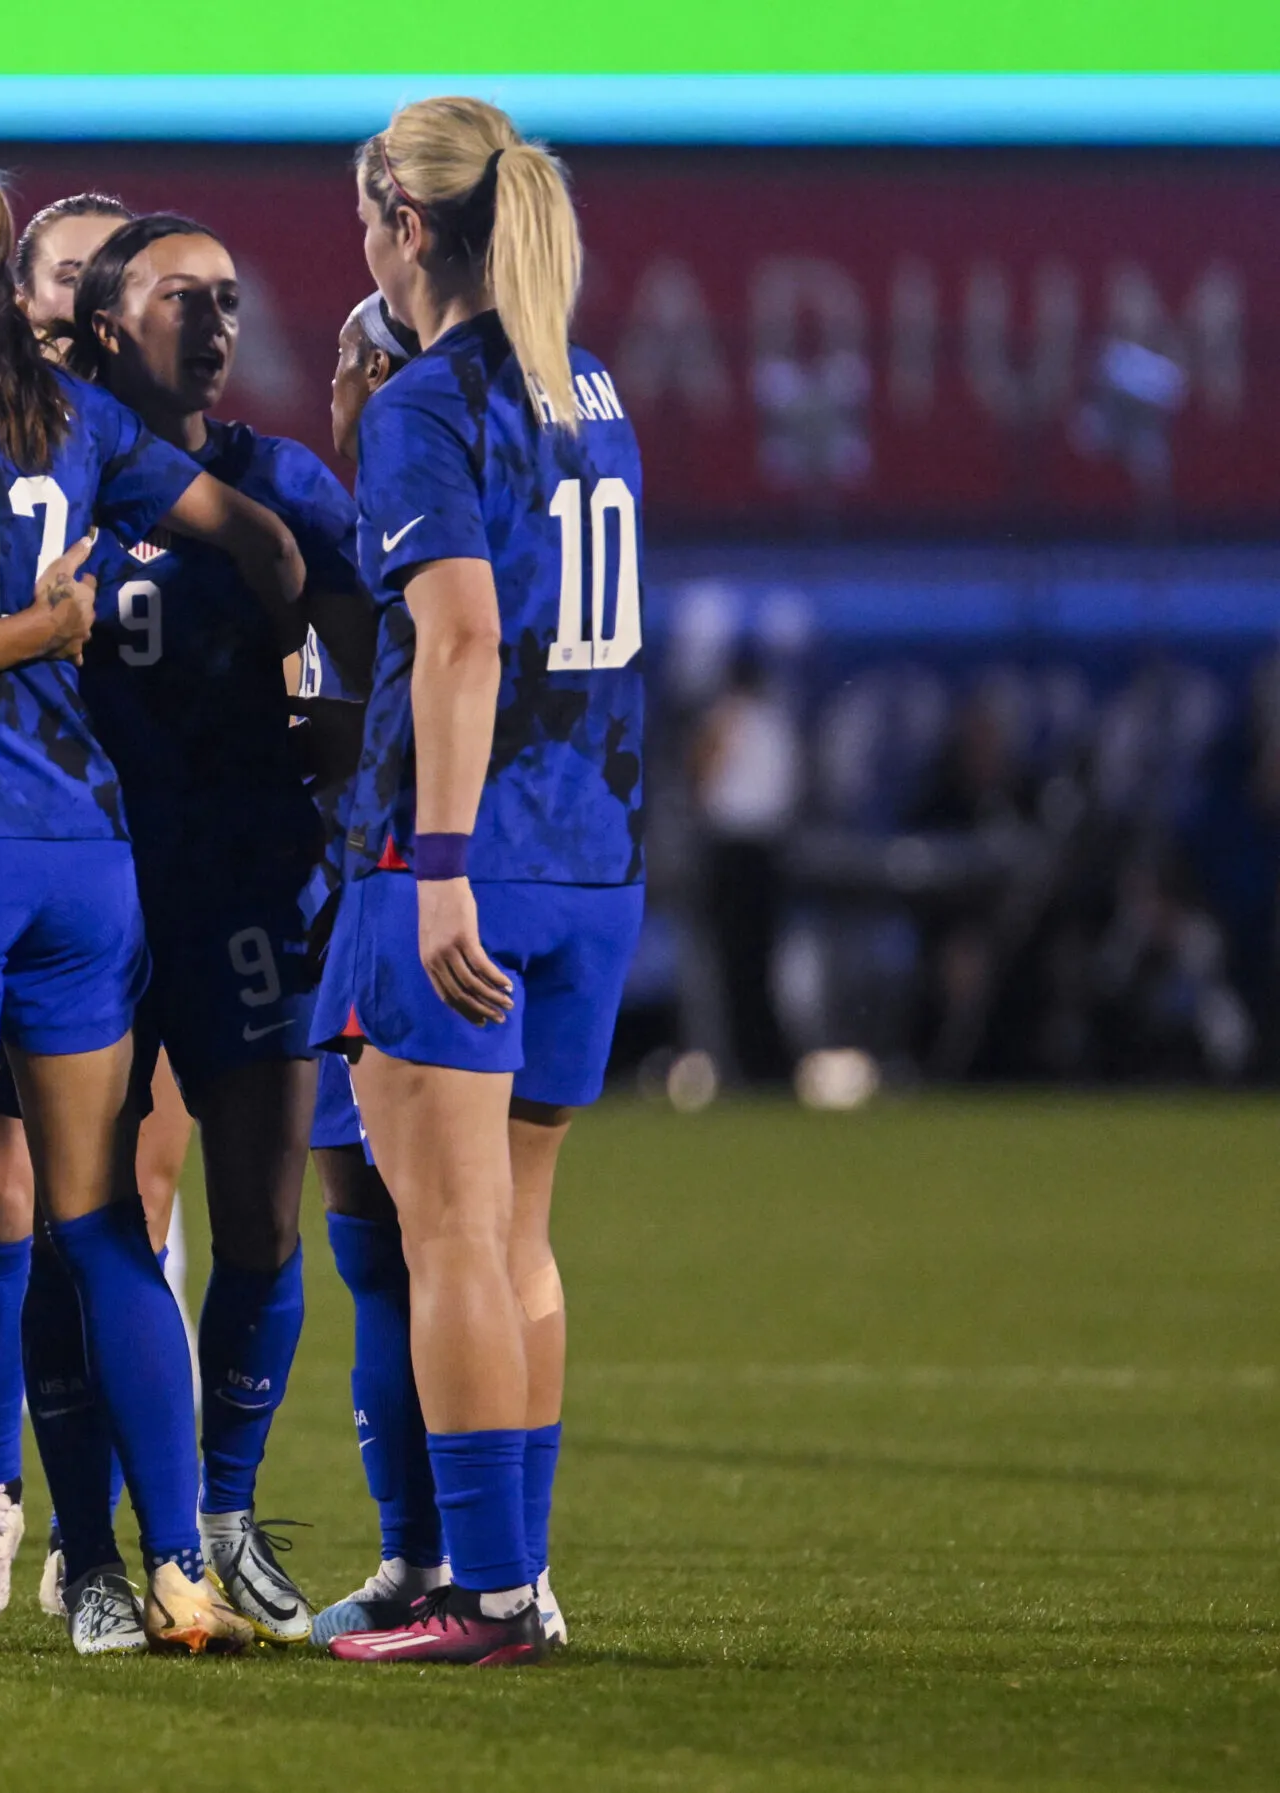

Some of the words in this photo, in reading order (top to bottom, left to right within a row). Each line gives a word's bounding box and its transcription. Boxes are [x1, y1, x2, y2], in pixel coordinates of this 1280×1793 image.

[612, 252, 1246, 421] ADIUM
[528, 371, 624, 424] HAN
[546, 478, 642, 671] 10
[118, 580, 162, 666] 9
[228, 926, 280, 1007] 9
[227, 1368, 271, 1391] USA
